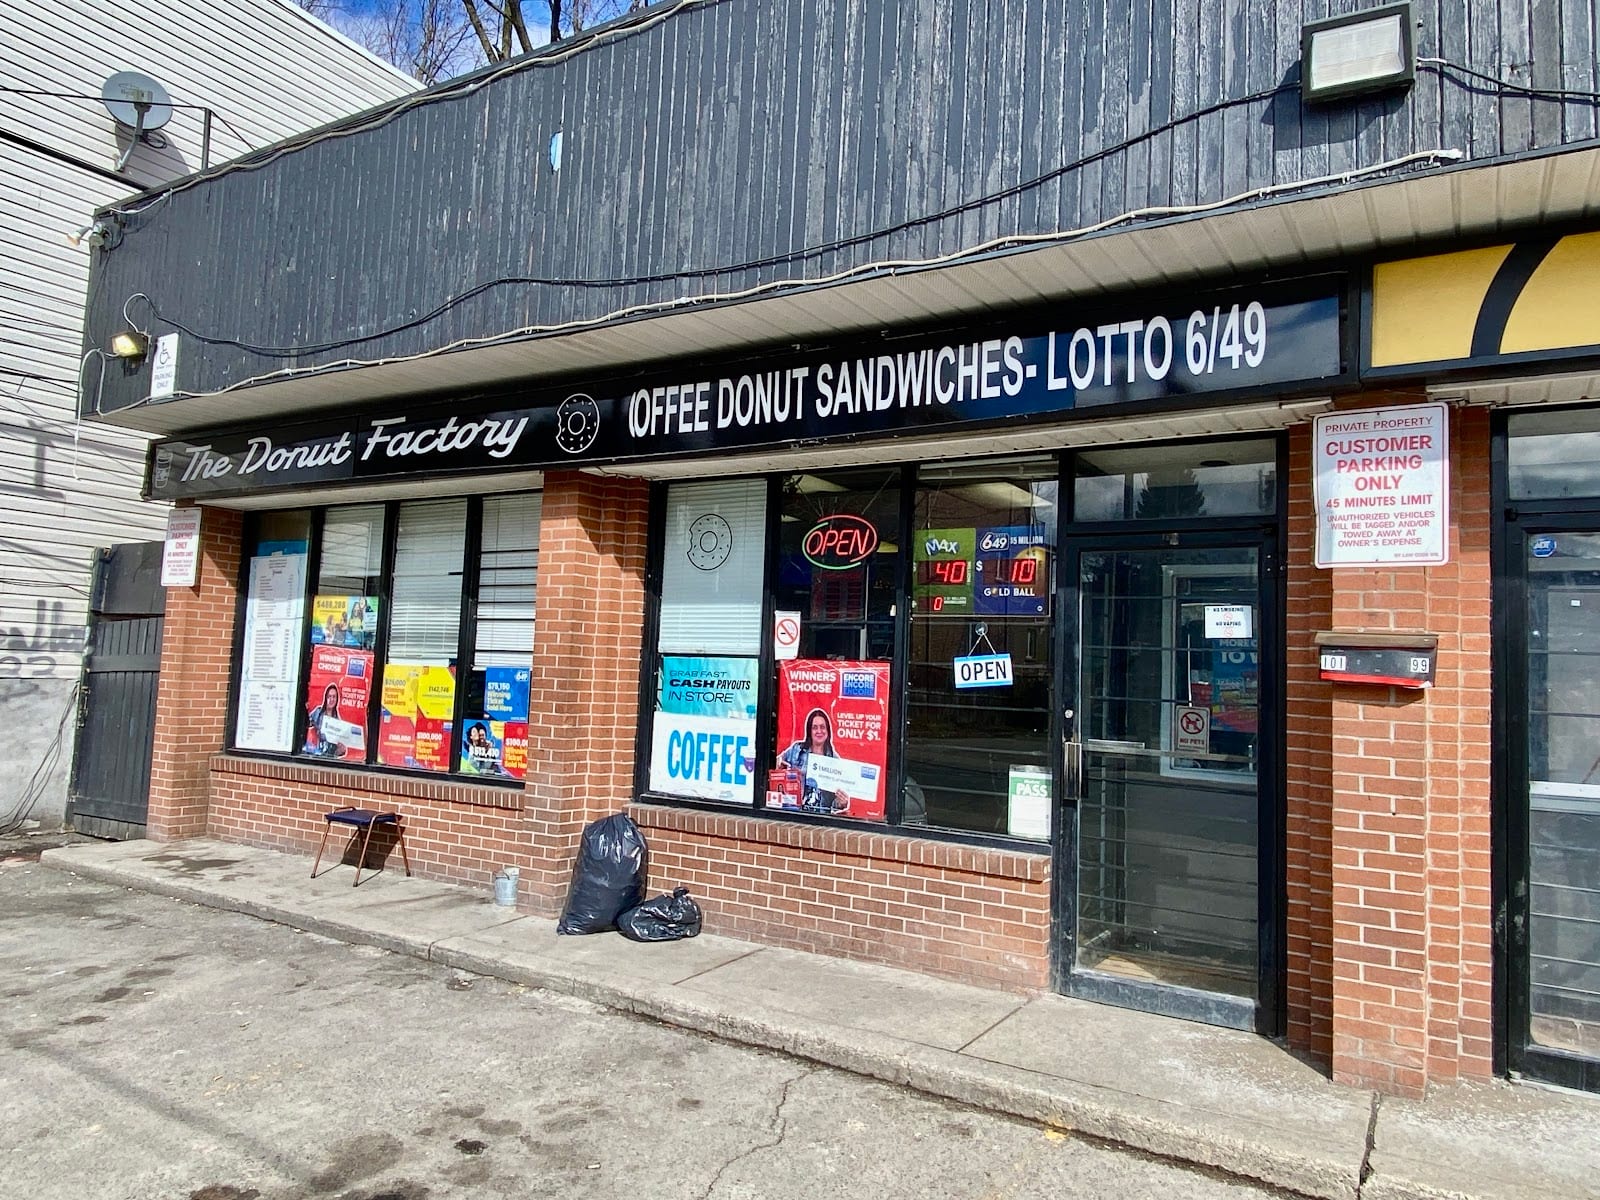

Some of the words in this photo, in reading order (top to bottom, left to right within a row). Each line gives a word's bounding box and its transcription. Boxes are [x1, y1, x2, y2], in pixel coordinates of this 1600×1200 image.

[717, 366, 808, 429] DONUT
[1048, 316, 1172, 390] LOTTO
[1186, 301, 1266, 376] 6/49
[1325, 422, 1368, 433] PRIVATE
[1374, 417, 1432, 428] PROPERTY
[181, 445, 232, 482] The
[237, 432, 351, 474] Donut
[361, 417, 529, 460] Factory
[1326, 435, 1432, 456] CUSTOMER
[1337, 455, 1422, 473] PARKING
[1355, 475, 1403, 491] ONLY
[1326, 498, 1340, 508] 45
[1344, 496, 1396, 507] MINUTES
[1401, 495, 1432, 505] LIMIT
[1327, 513, 1389, 522] UNAUTHORIZED
[1394, 511, 1435, 519] VEHICLES
[1331, 522, 1347, 530] WILL
[1351, 521, 1361, 529] BE
[1365, 520, 1395, 528] TAGGED
[1399, 520, 1430, 528] AND/OR
[1018, 536, 1043, 544] MILLION
[1406, 529, 1416, 537] AT
[806, 530, 870, 555] OPEN
[926, 538, 959, 556] MAX
[1382, 538, 1422, 546] EXPENSE
[936, 562, 966, 582] 40
[976, 560, 983, 571] $
[1011, 560, 1035, 582] 10
[1014, 588, 1035, 596] BALL
[961, 660, 1006, 681] OPEN
[1324, 657, 1342, 668] 101
[1412, 659, 1427, 671] 99
[789, 670, 836, 681] WINNERS
[669, 679, 715, 688] CASH
[716, 680, 750, 690] PAYOUTS
[789, 682, 832, 693] CHOOSE
[837, 720, 864, 728] TICKET
[866, 721, 881, 729] FOR
[837, 728, 864, 739] ONLY
[668, 730, 748, 785] COFFEE
[822, 767, 842, 775] MILLION
[1016, 783, 1047, 797] PASS
